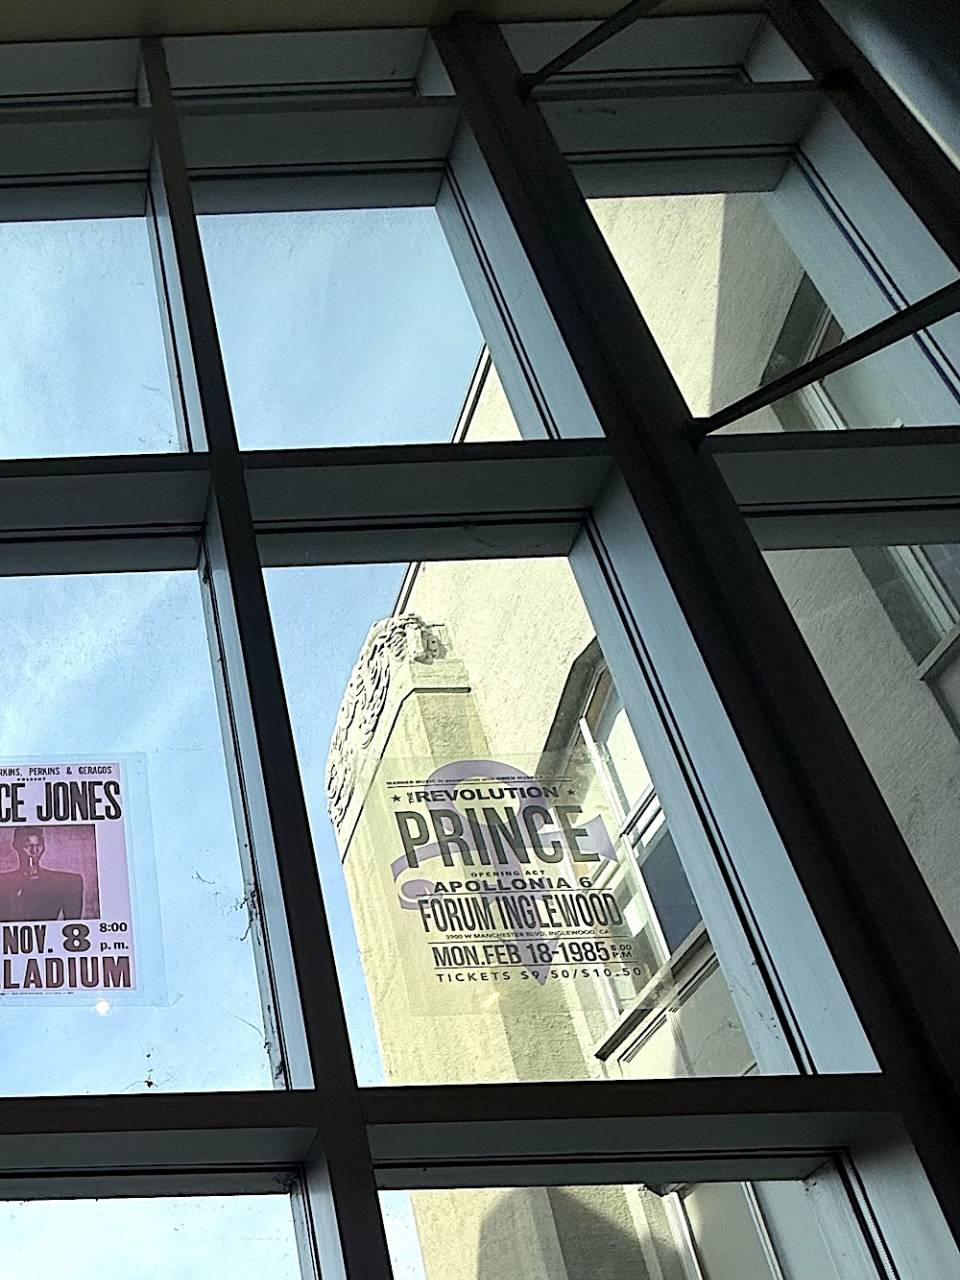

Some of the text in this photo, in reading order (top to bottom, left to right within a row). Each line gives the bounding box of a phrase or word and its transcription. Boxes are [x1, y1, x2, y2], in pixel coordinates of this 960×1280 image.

[28, 767, 61, 776] PERKINS
[36, 780, 122, 821] JONES
[415, 786, 559, 802] REVOLUTION
[394, 805, 601, 869] PRINCE
[434, 876, 592, 894] APOLLONIA 6
[418, 893, 624, 933] FORUM INGLEWOOD
[99, 922, 128, 933] 8:00
[2, 925, 53, 955] NOV.
[62, 923, 92, 952] 8
[526, 941, 610, 964] 18-1985
[437, 971, 511, 983] TICKETS
